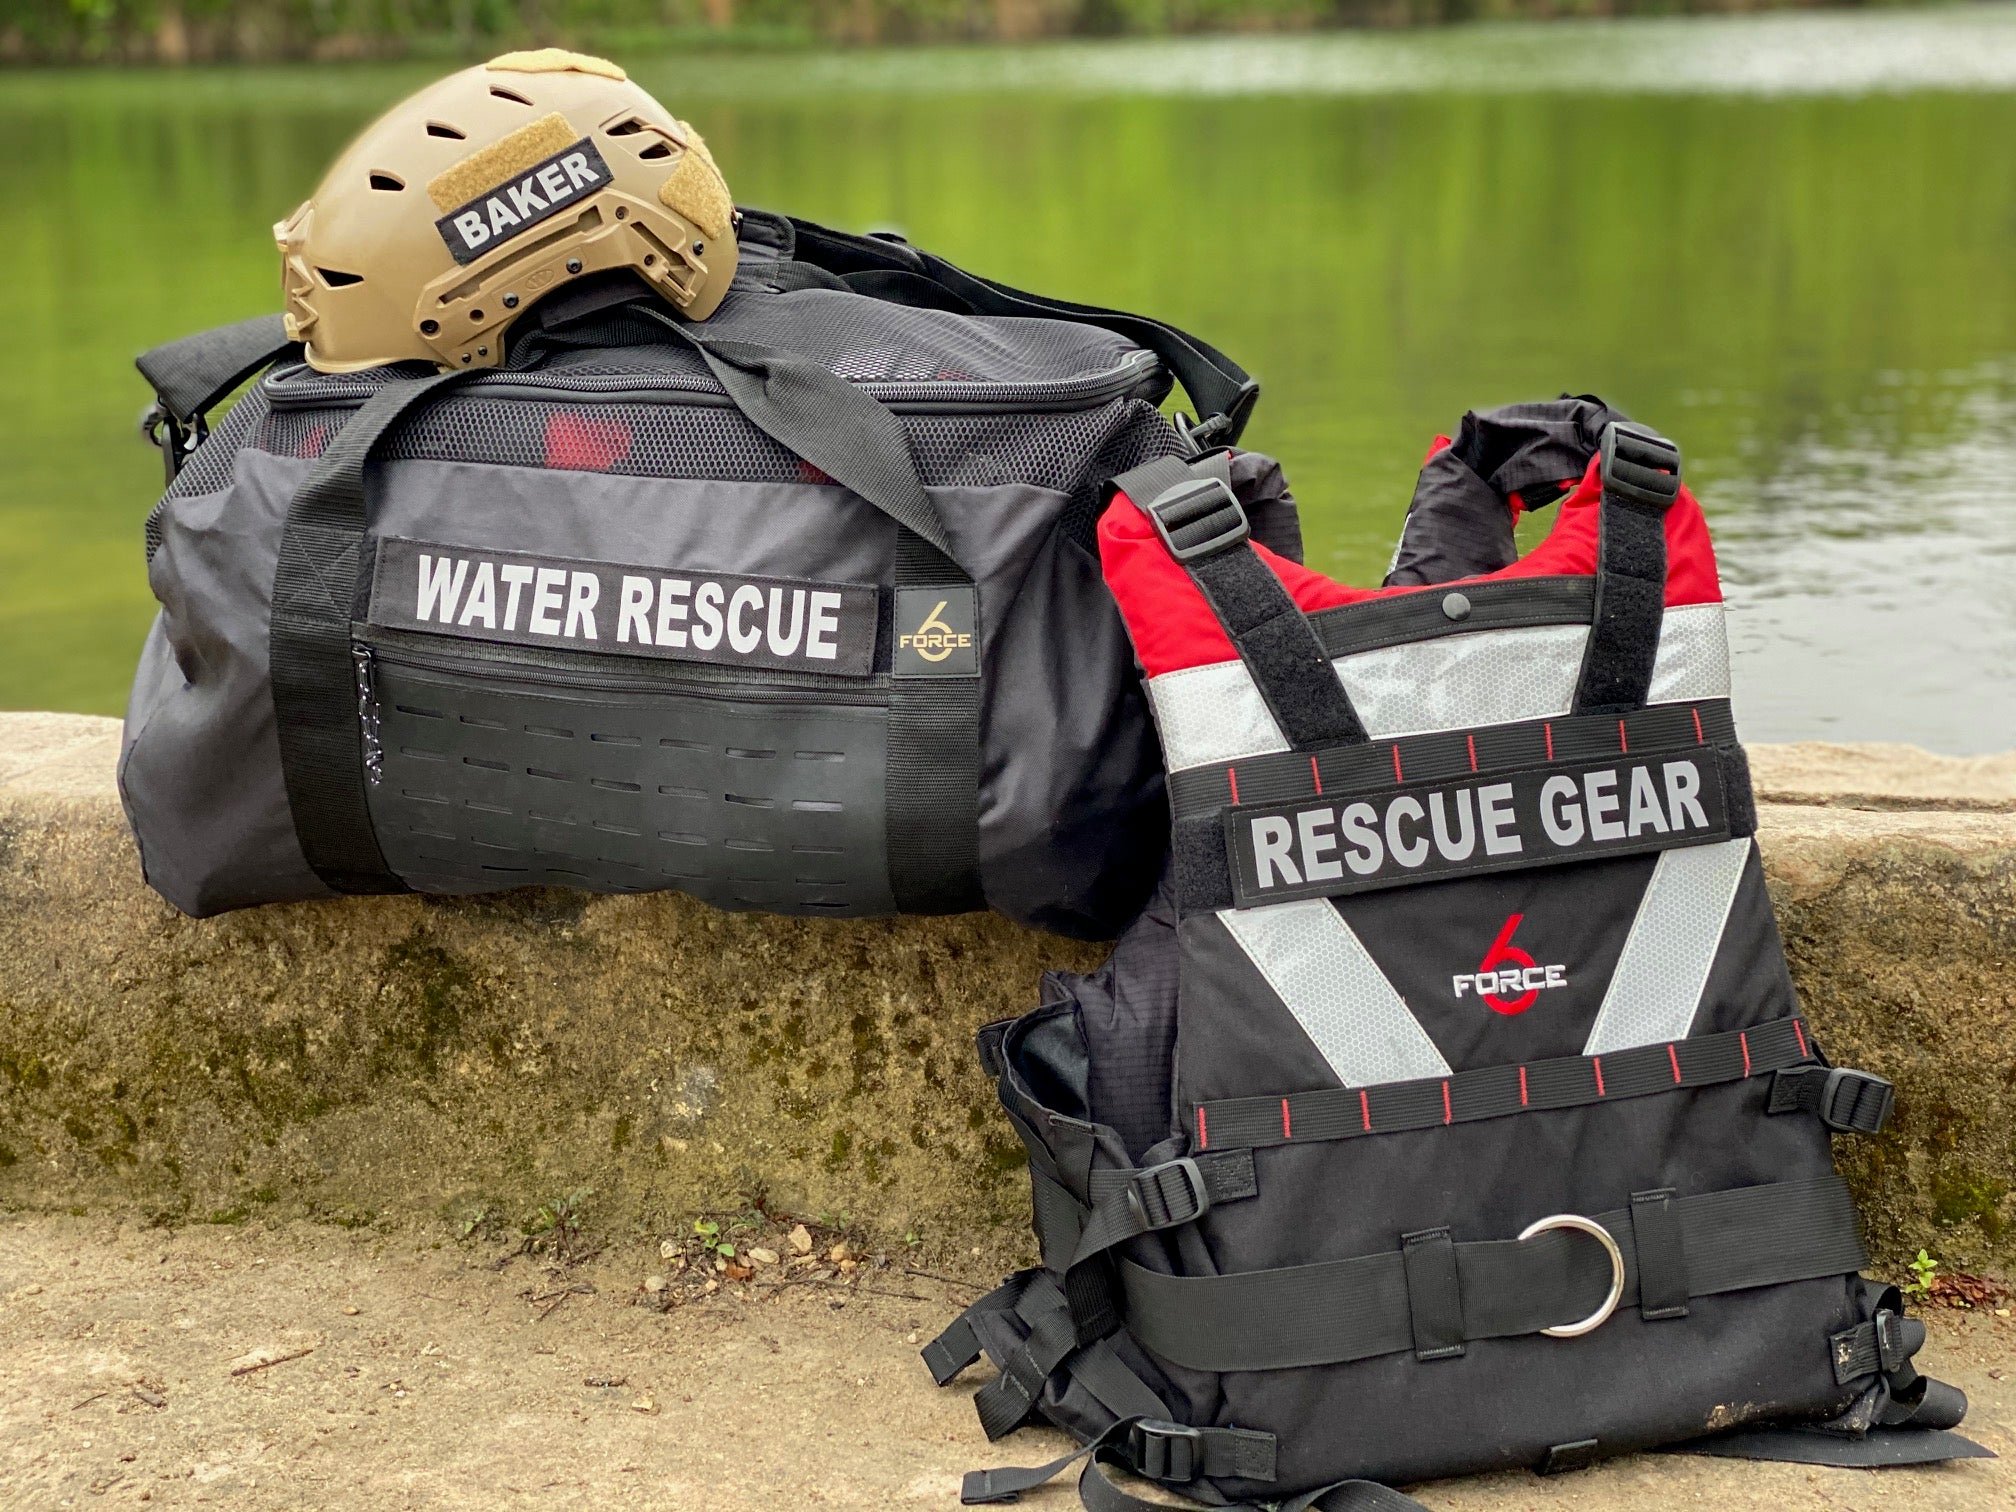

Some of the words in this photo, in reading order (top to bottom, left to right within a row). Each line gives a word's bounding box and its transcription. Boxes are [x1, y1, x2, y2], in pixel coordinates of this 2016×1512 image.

[453, 152, 600, 250] BAKER
[416, 554, 600, 640] WATER
[616, 575, 842, 660] RESCUE
[899, 633, 972, 649] FORCE
[917, 600, 953, 662] 6
[1250, 783, 1523, 888] RESCUE
[1540, 761, 1709, 847] GEAR
[1452, 964, 1568, 998] FORCE
[1480, 913, 1539, 1016] 6
